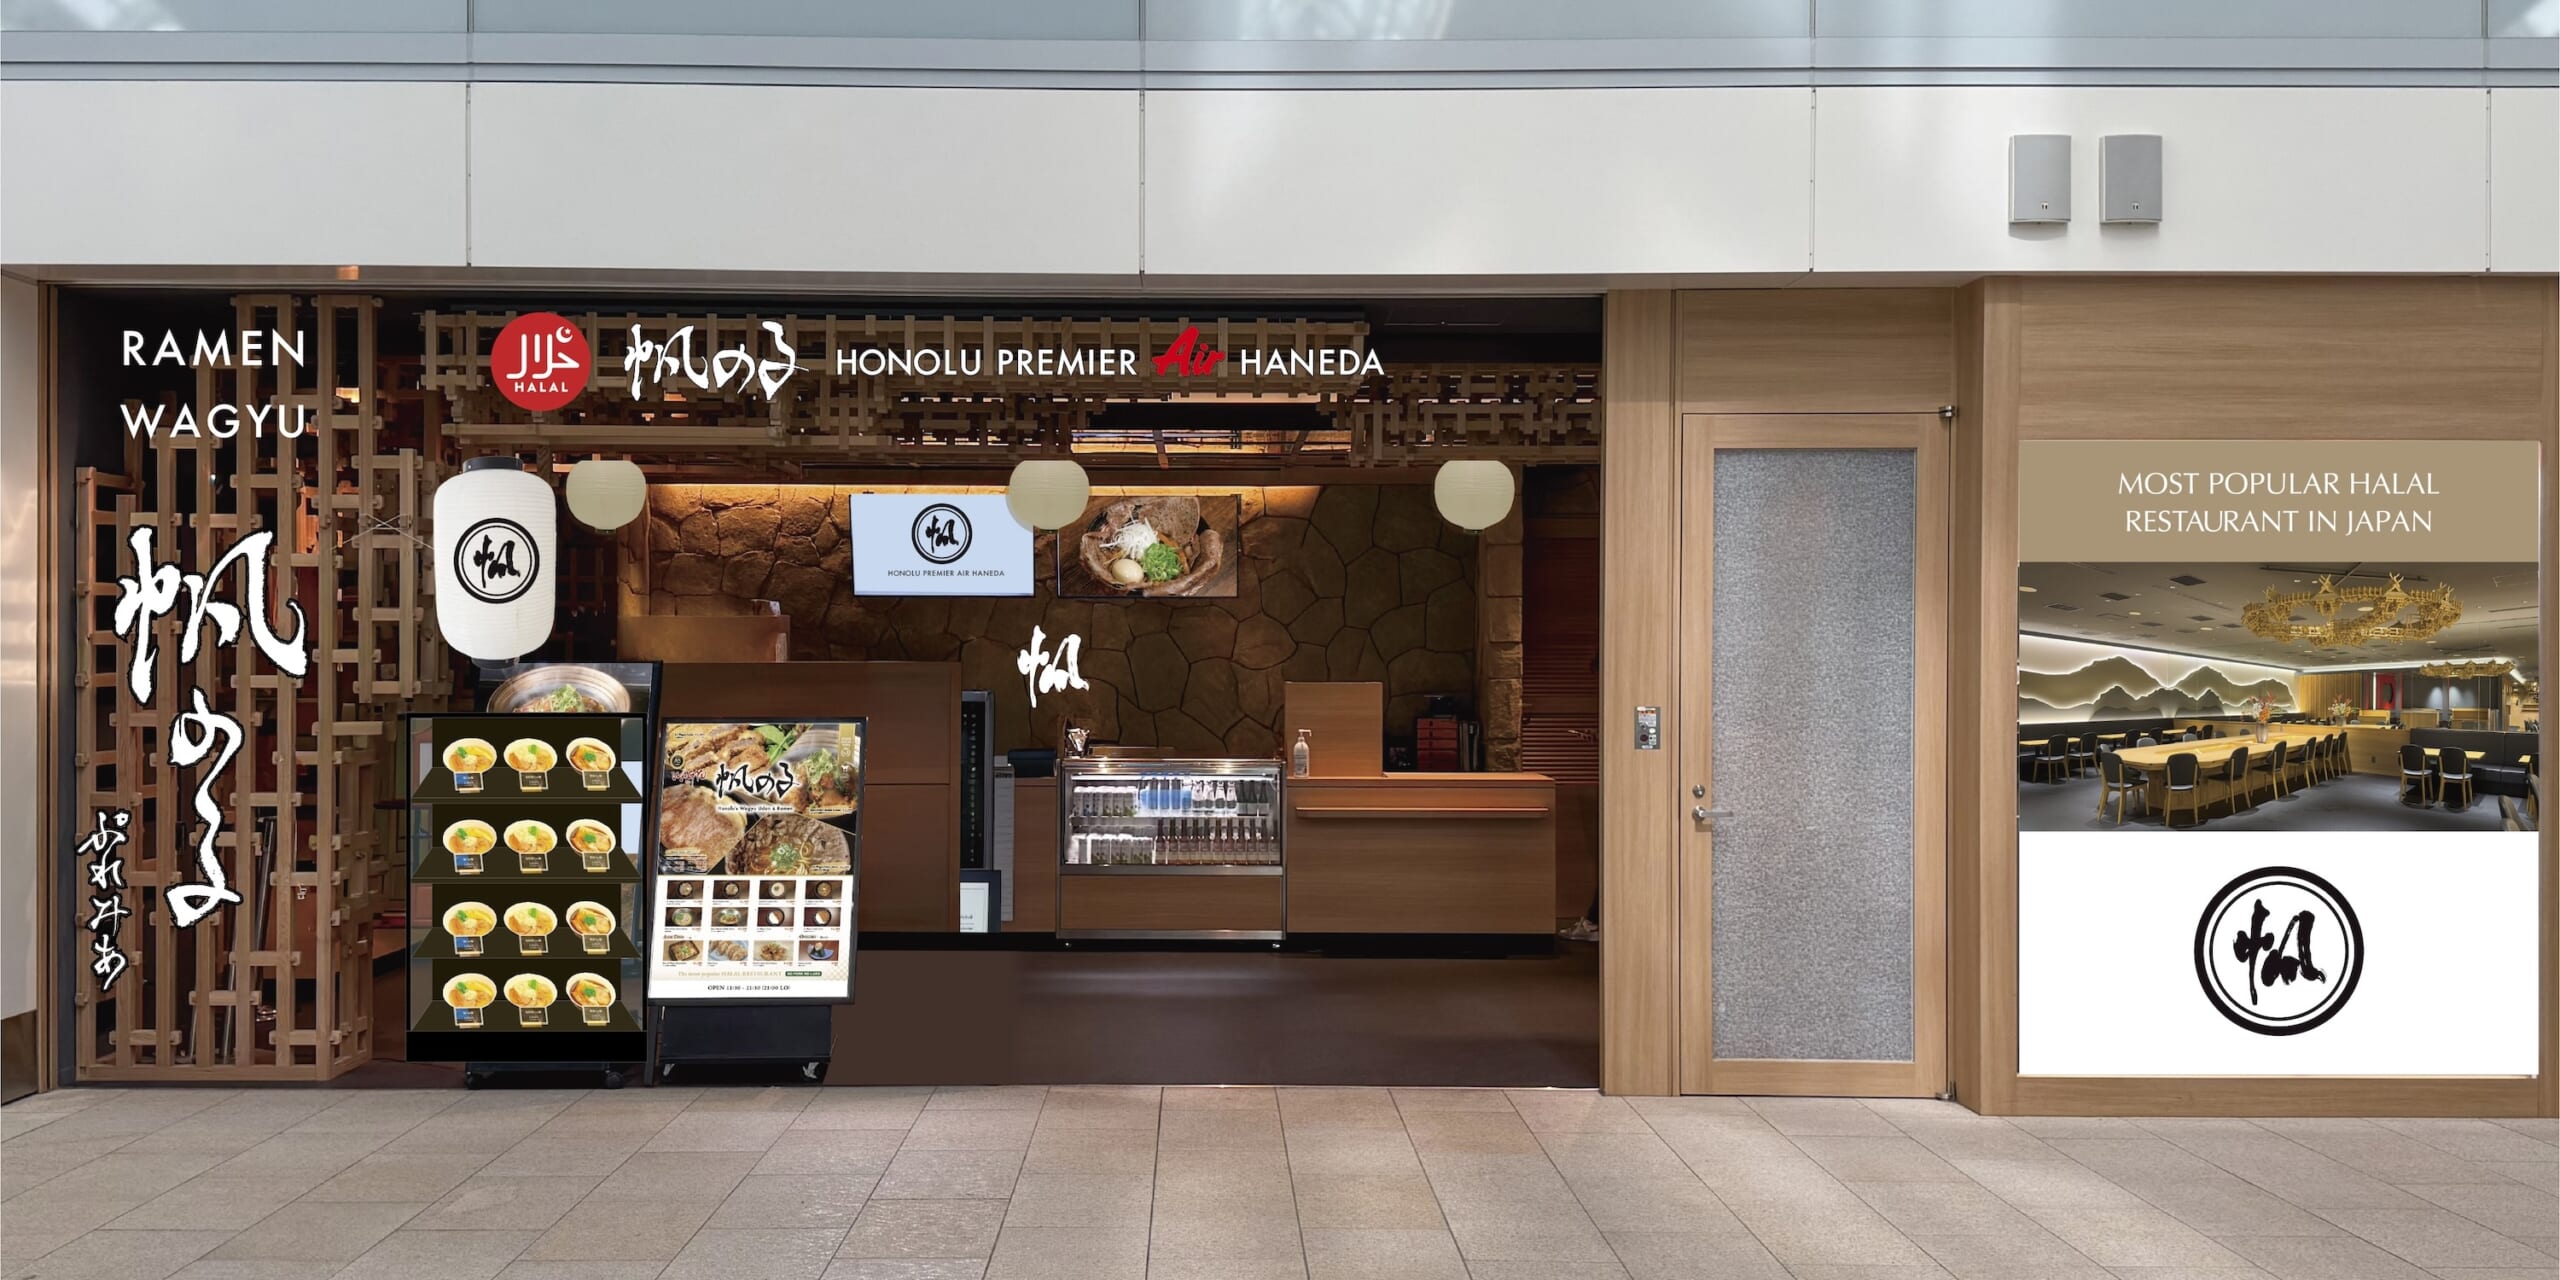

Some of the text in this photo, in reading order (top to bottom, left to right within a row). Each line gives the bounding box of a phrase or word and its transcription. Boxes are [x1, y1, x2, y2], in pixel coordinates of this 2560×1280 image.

[123, 329, 305, 367] RAMEN
[837, 325, 1385, 377] HONOLU PREMIER Air HANEDA
[514, 381, 569, 393] HALAL
[120, 403, 305, 439] WAGYU
[2118, 472, 2441, 495] MOST POPULAR HALAL
[2126, 510, 2432, 536] RESTAURANT IN JAPAN
[887, 569, 1005, 577] HONOLU PREMIER AIR HANEDA
